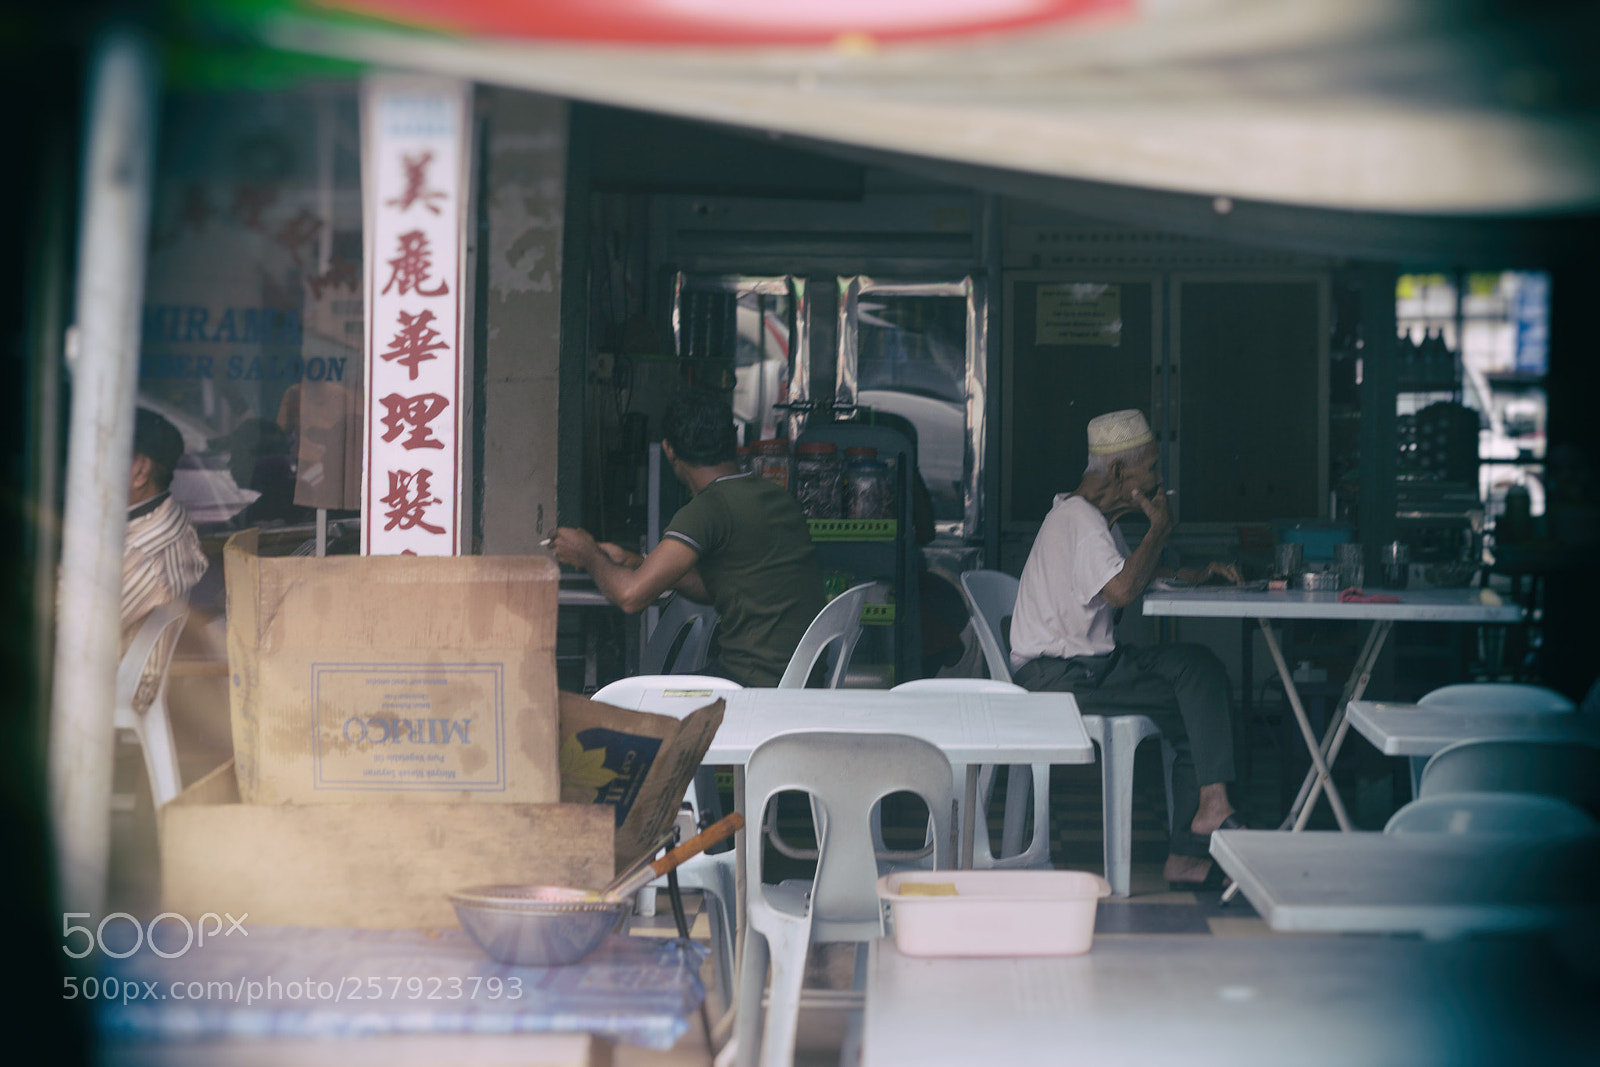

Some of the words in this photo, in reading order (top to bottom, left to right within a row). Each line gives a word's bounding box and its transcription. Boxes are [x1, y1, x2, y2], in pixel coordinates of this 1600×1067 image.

[380, 150, 449, 556] 美麗華理髮
[227, 355, 347, 382] SALOON
[344, 718, 471, 744] MIRICO
[427, 754, 445, 763] Pure
